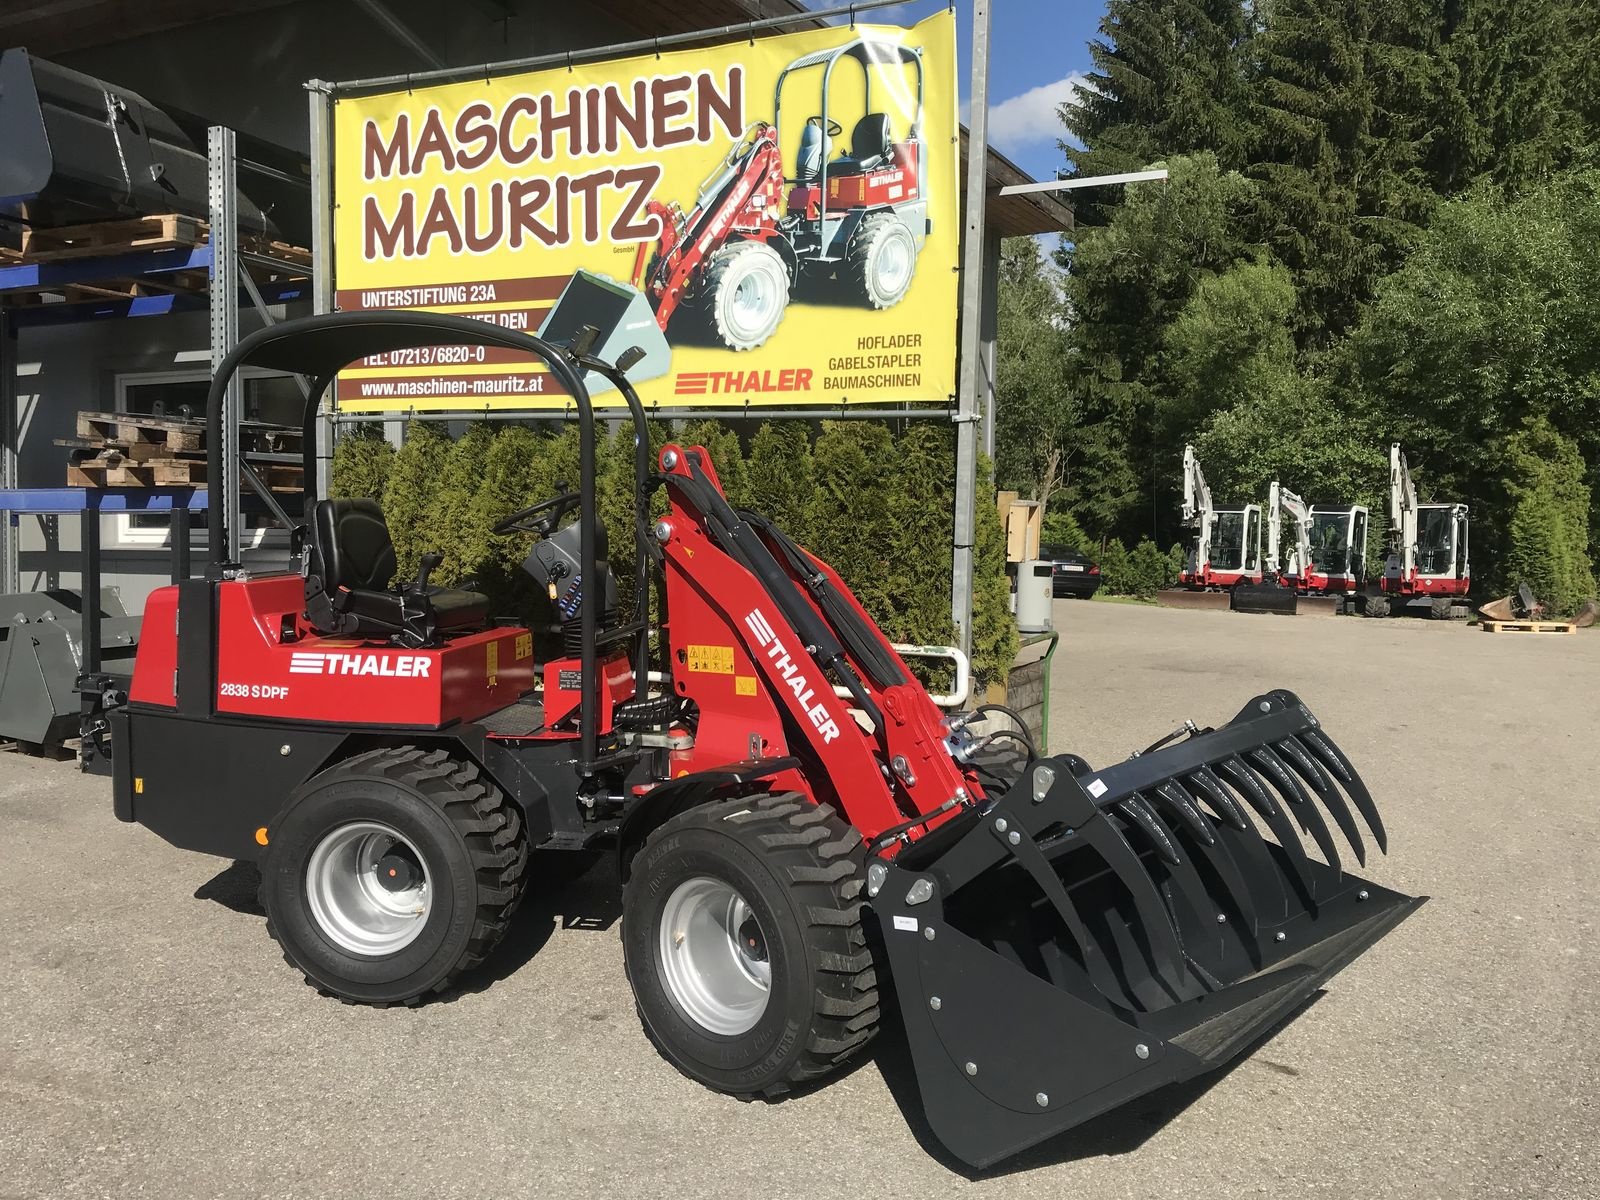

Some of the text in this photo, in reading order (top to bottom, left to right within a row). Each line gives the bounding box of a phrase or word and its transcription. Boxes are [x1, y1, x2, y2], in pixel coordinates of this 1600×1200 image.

[365, 68, 742, 179] MASCHINEN
[365, 165, 660, 259] MAURITZ
[613, 246, 635, 254] GesmbH
[362, 284, 496, 308] UNTERSTIFTUNG 23A
[857, 334, 922, 350] HOFLADER
[390, 346, 485, 365] 07213/6820-0
[829, 354, 922, 371] GABELSTAPLER
[362, 375, 543, 396] www.maschinen-mauritz.at
[707, 368, 813, 394] THALER
[823, 373, 921, 390] BAUMASCHINEN
[326, 653, 432, 678] THALER
[220, 683, 250, 698] 2838
[768, 637, 840, 744] THALER
